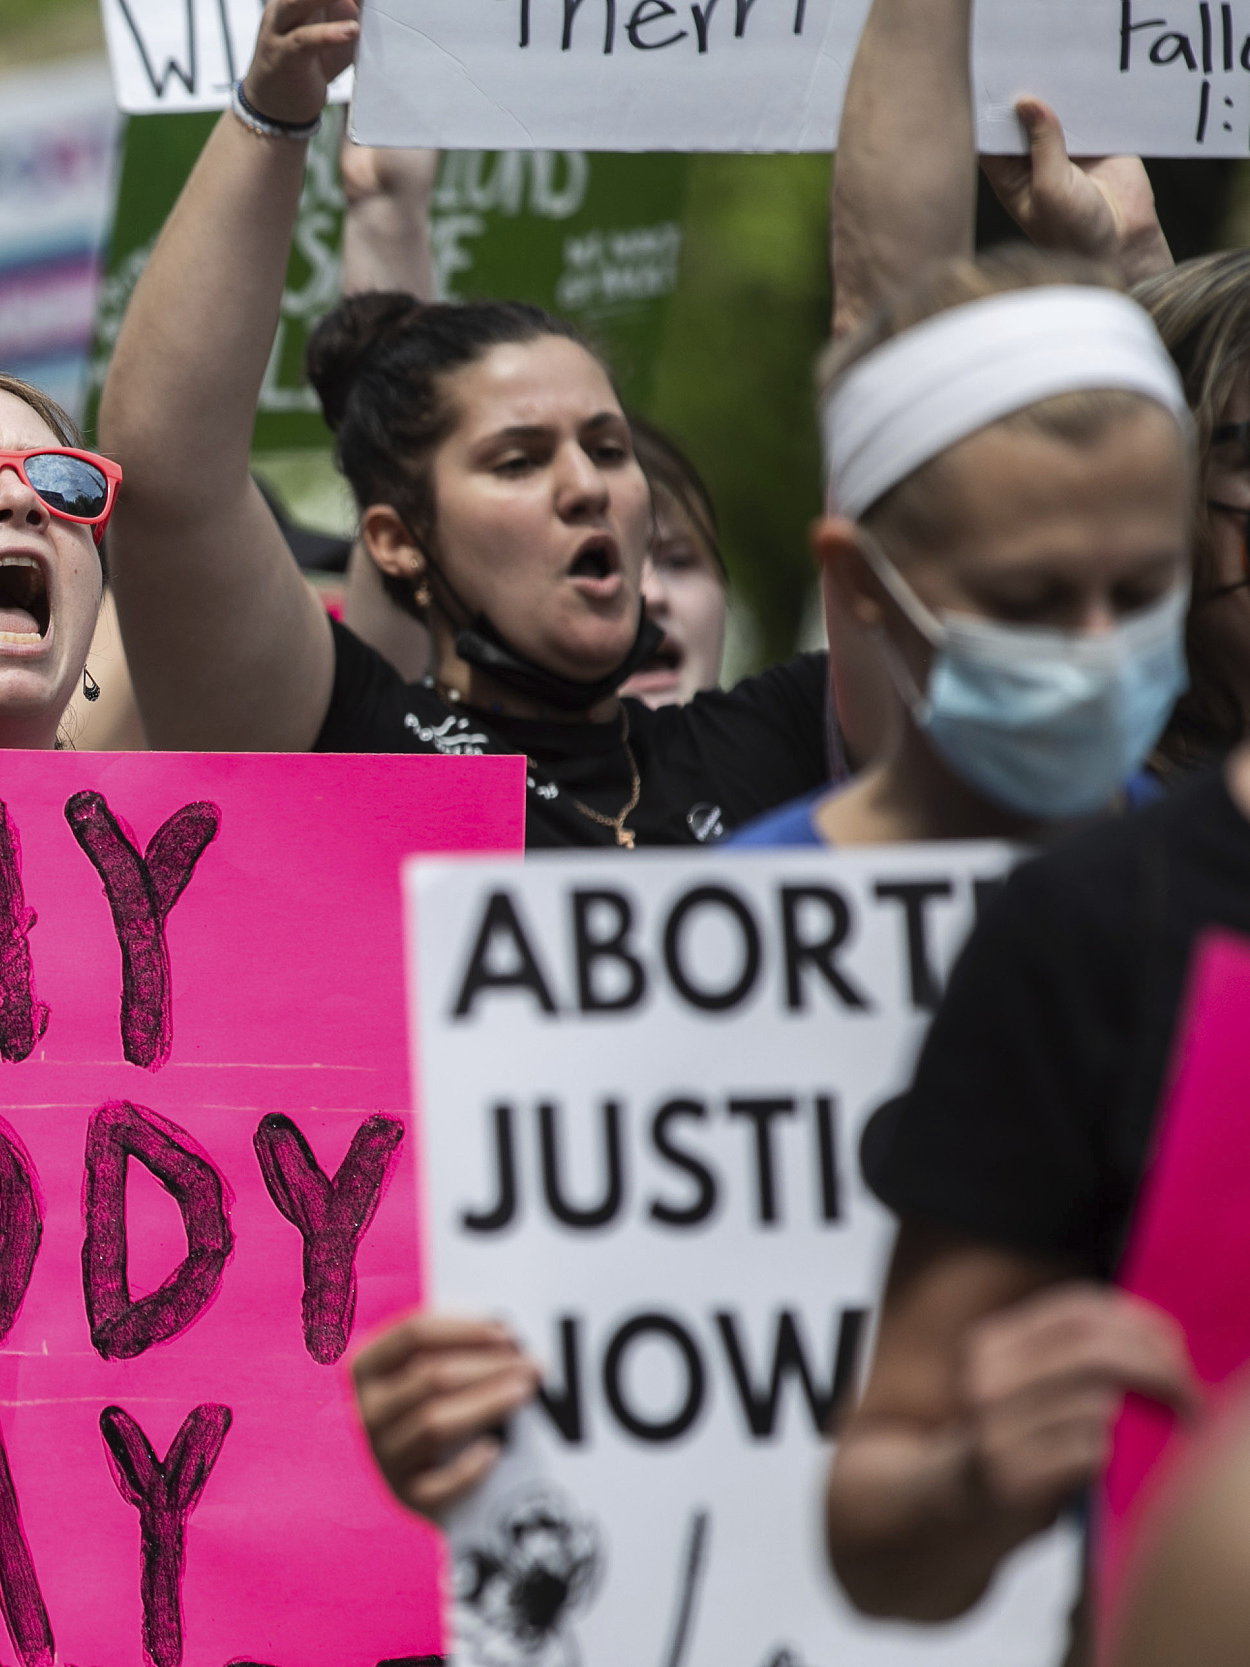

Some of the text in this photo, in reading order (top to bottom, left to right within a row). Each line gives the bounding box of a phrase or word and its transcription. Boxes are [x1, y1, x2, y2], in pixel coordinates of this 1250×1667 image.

[1120, 0, 1250, 75] Fall
[450, 876, 1002, 1022] ABORT
[461, 1094, 875, 1236] JUSTI
